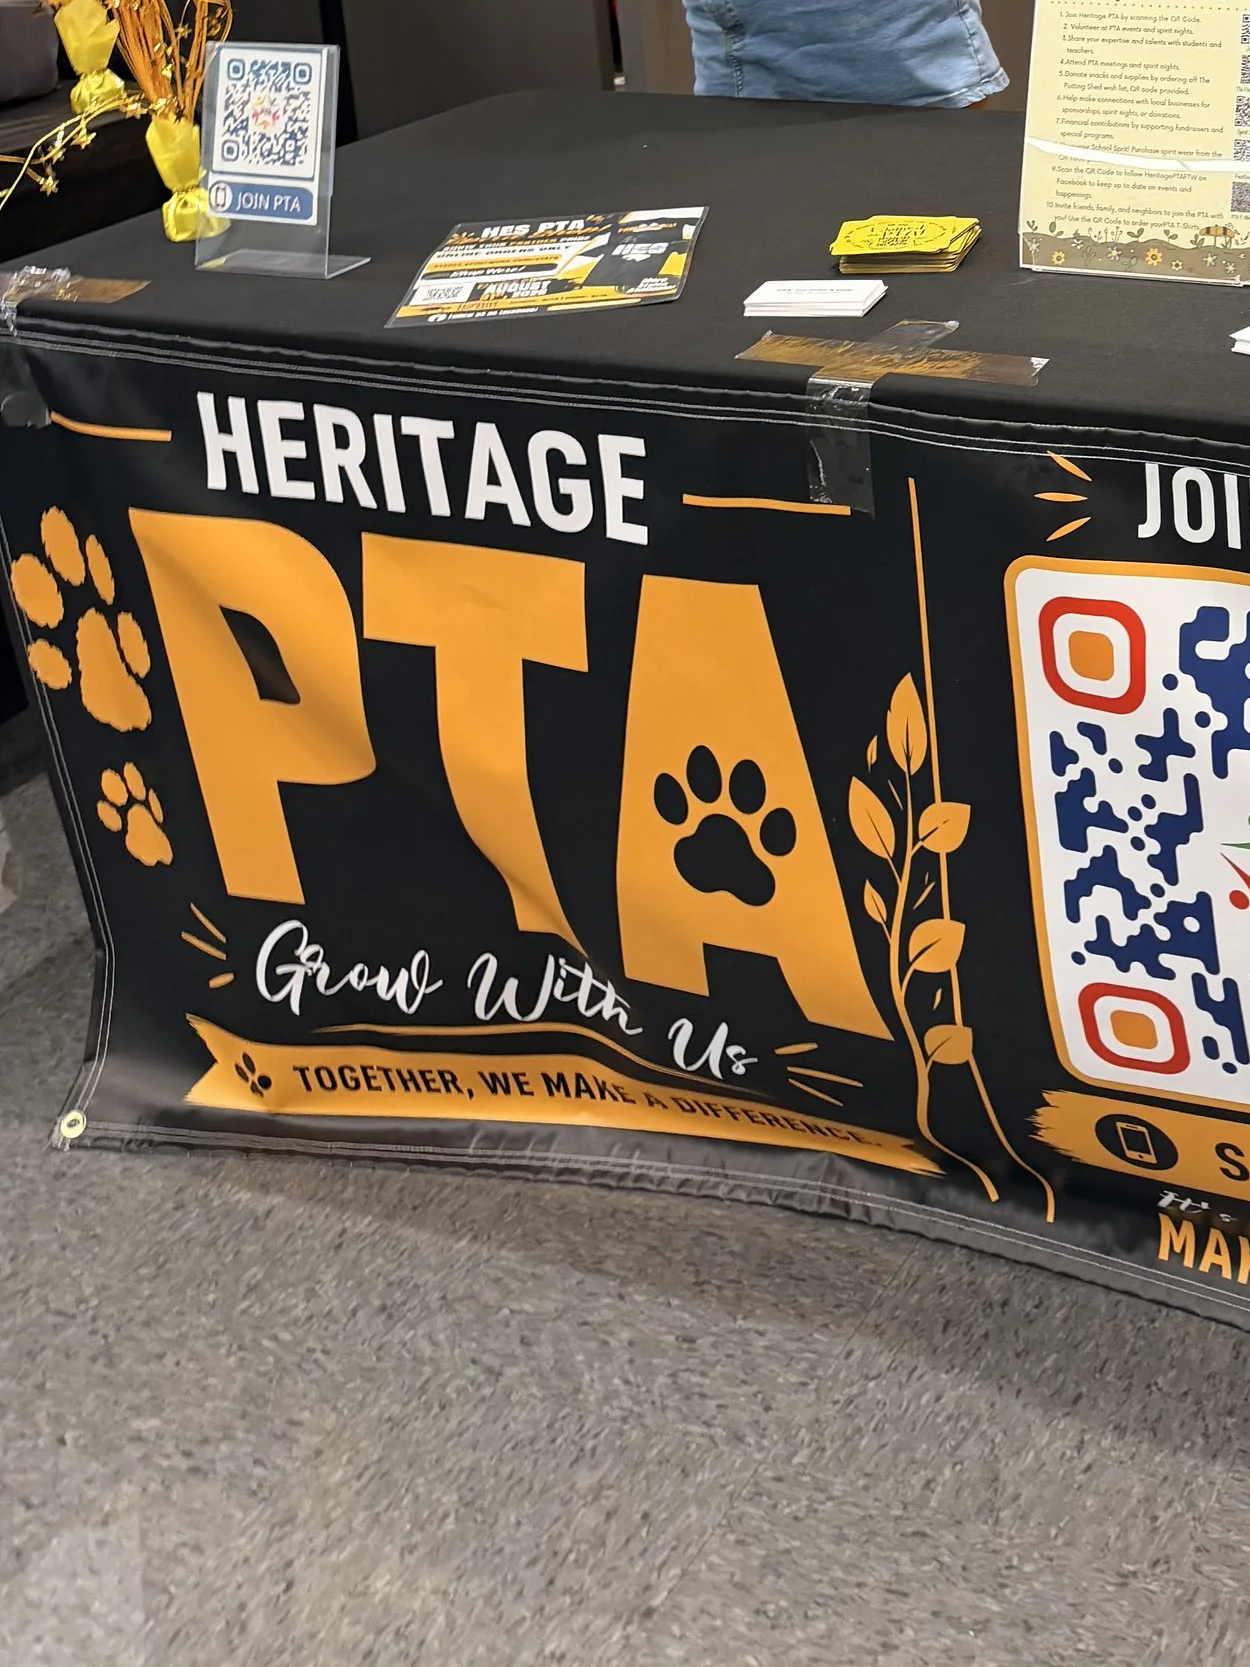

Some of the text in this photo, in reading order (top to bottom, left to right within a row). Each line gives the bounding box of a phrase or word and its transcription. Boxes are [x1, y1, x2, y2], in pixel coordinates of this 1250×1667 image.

[1077, 11, 1107, 20] Heritage
[1120, 13, 1128, 21] by
[1129, 13, 1157, 23] scanning
[1157, 27, 1172, 36] spirit
[1173, 28, 1194, 37] nights.
[1086, 36, 1099, 44] your
[1100, 60, 1127, 69] meetings
[1143, 62, 1158, 71] spirit
[1159, 63, 1180, 72] nights.
[1124, 73, 1148, 82] supplies
[1150, 74, 1158, 83] by
[1159, 75, 1186, 84] ordering
[1063, 82, 1085, 91] Potting
[1159, 87, 1190, 96] provided.
[1167, 99, 1199, 107] businesses
[1062, 106, 1102, 116] sponsorships,
[1102, 108, 1117, 117] spirit
[1119, 109, 1139, 118] nights,
[1090, 119, 1129, 127] contributions
[1131, 122, 1138, 130] by
[1140, 122, 1173, 132] supporting
[1175, 124, 1209, 132] fundraisers
[1060, 130, 1114, 140] special programs.
[1161, 147, 1176, 156] spirit
[1056, 177, 1086, 185] Facebook
[1096, 180, 1111, 189] keep
[1055, 190, 1093, 200] happenings.
[236, 191, 301, 212] JOIN PTA
[1096, 204, 1116, 213] family,
[1131, 206, 1162, 216] neighbors
[1172, 209, 1183, 217] join
[1053, 214, 1066, 223] you!
[538, 219, 585, 233] PTA
[196, 391, 648, 545] HERITAGE
[129, 508, 894, 1041] PTA
[255, 919, 758, 1079] Grow With Us
[292, 1064, 476, 1100] TOGETHER,
[478, 1069, 534, 1099] WE
[541, 1072, 636, 1104] MAKE
[645, 1092, 669, 1111] A
